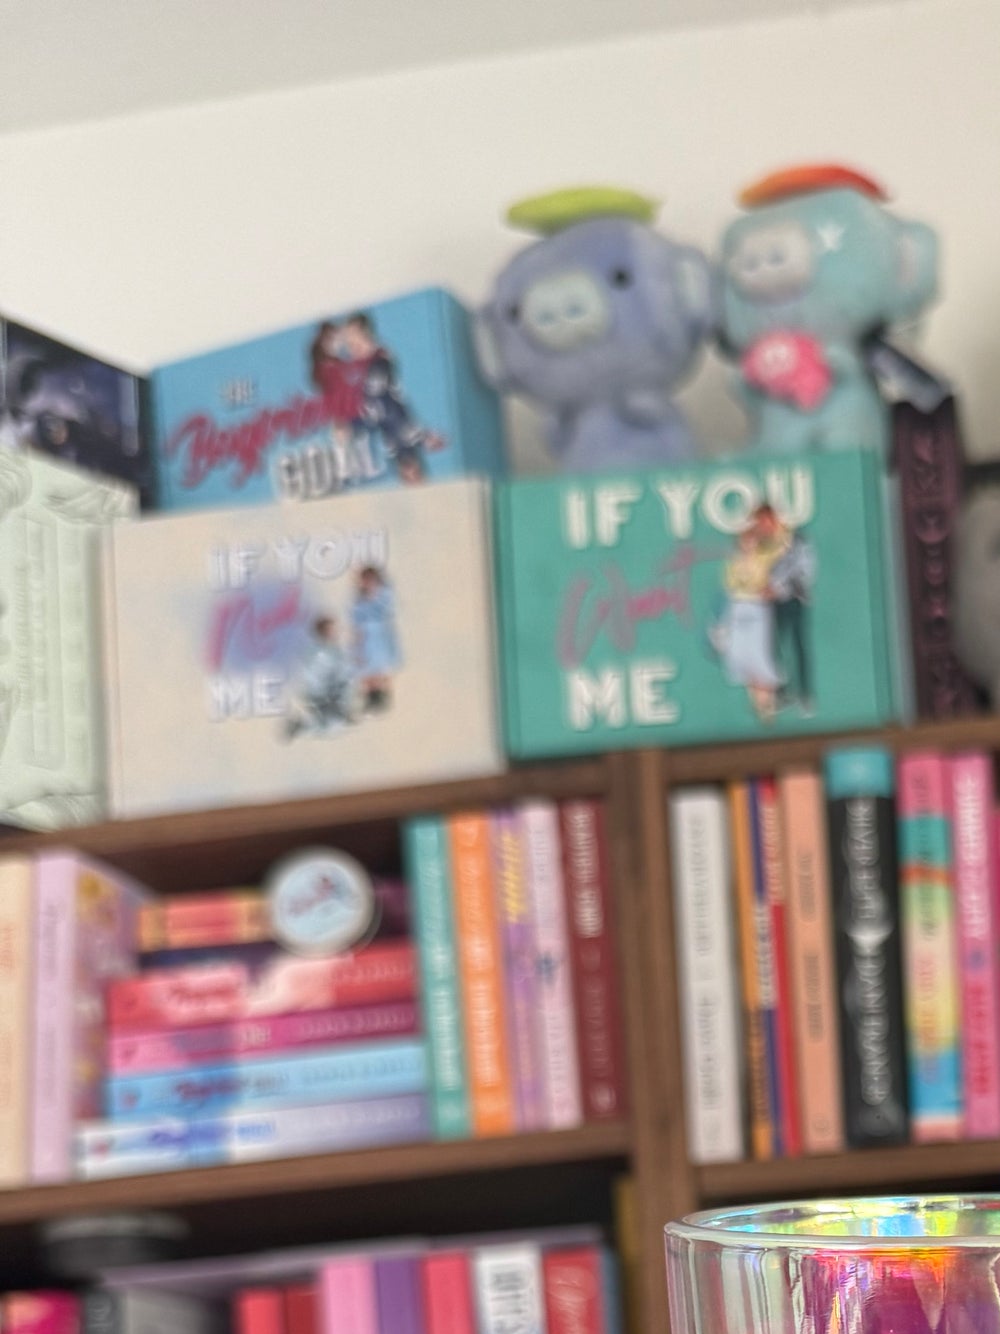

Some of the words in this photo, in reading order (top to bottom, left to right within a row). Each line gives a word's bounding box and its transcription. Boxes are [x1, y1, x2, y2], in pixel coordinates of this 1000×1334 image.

[564, 483, 641, 550] IF
[656, 462, 816, 539] YOU
[209, 542, 261, 587] IF
[273, 527, 388, 579] YOU
[208, 668, 291, 722] ME
[565, 658, 681, 732] ME
